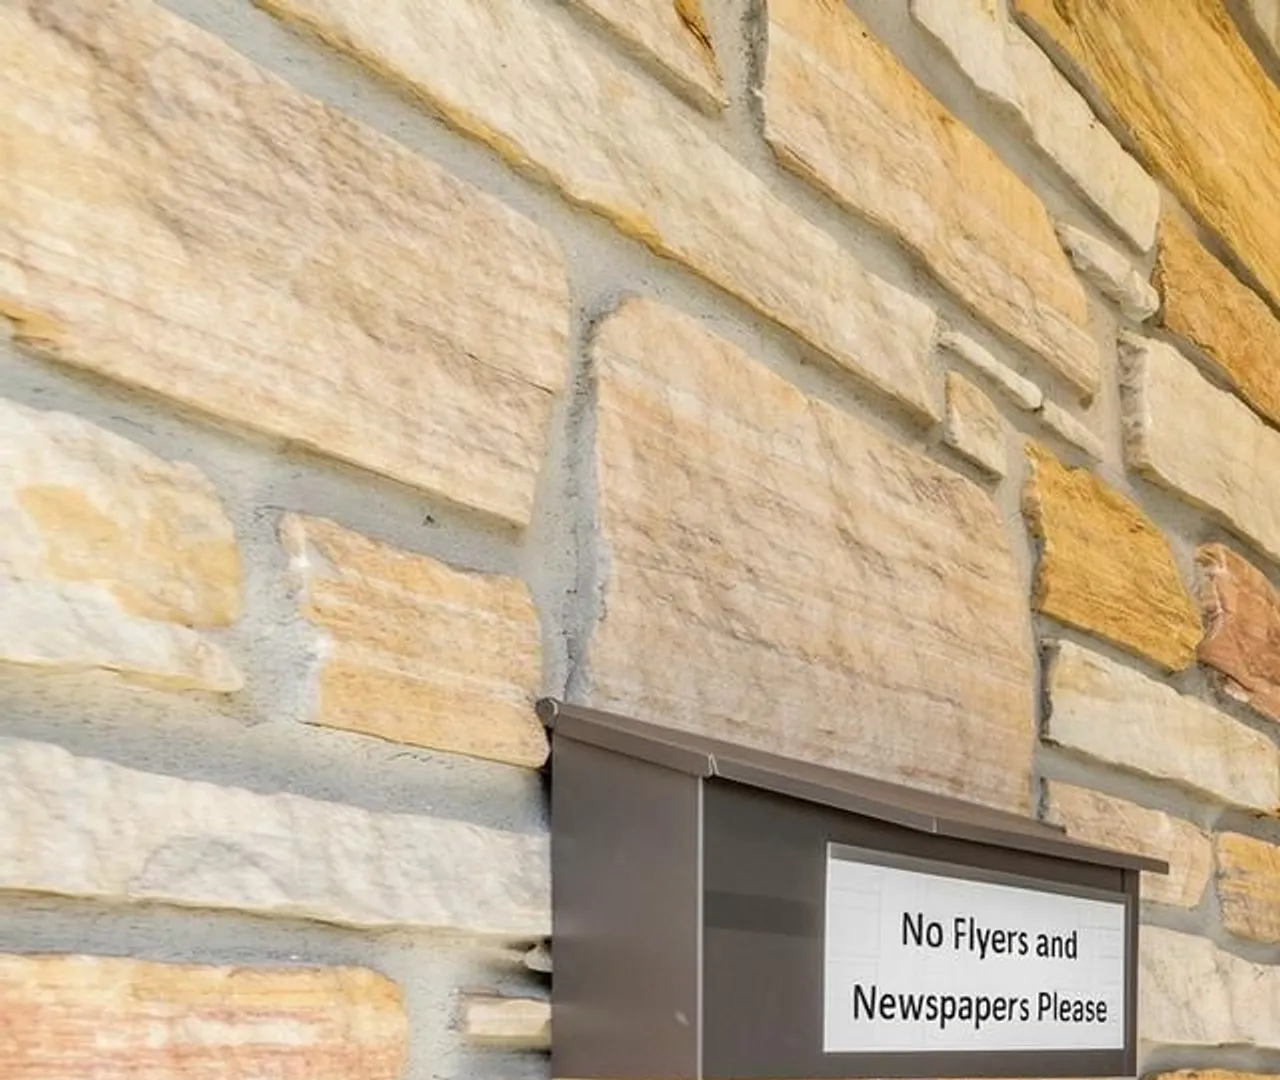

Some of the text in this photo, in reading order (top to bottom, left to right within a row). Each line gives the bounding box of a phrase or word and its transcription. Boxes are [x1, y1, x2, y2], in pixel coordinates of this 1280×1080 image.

[902, 912, 1077, 960] No Flyers and
[853, 984, 1107, 1029] Newspapers Please
